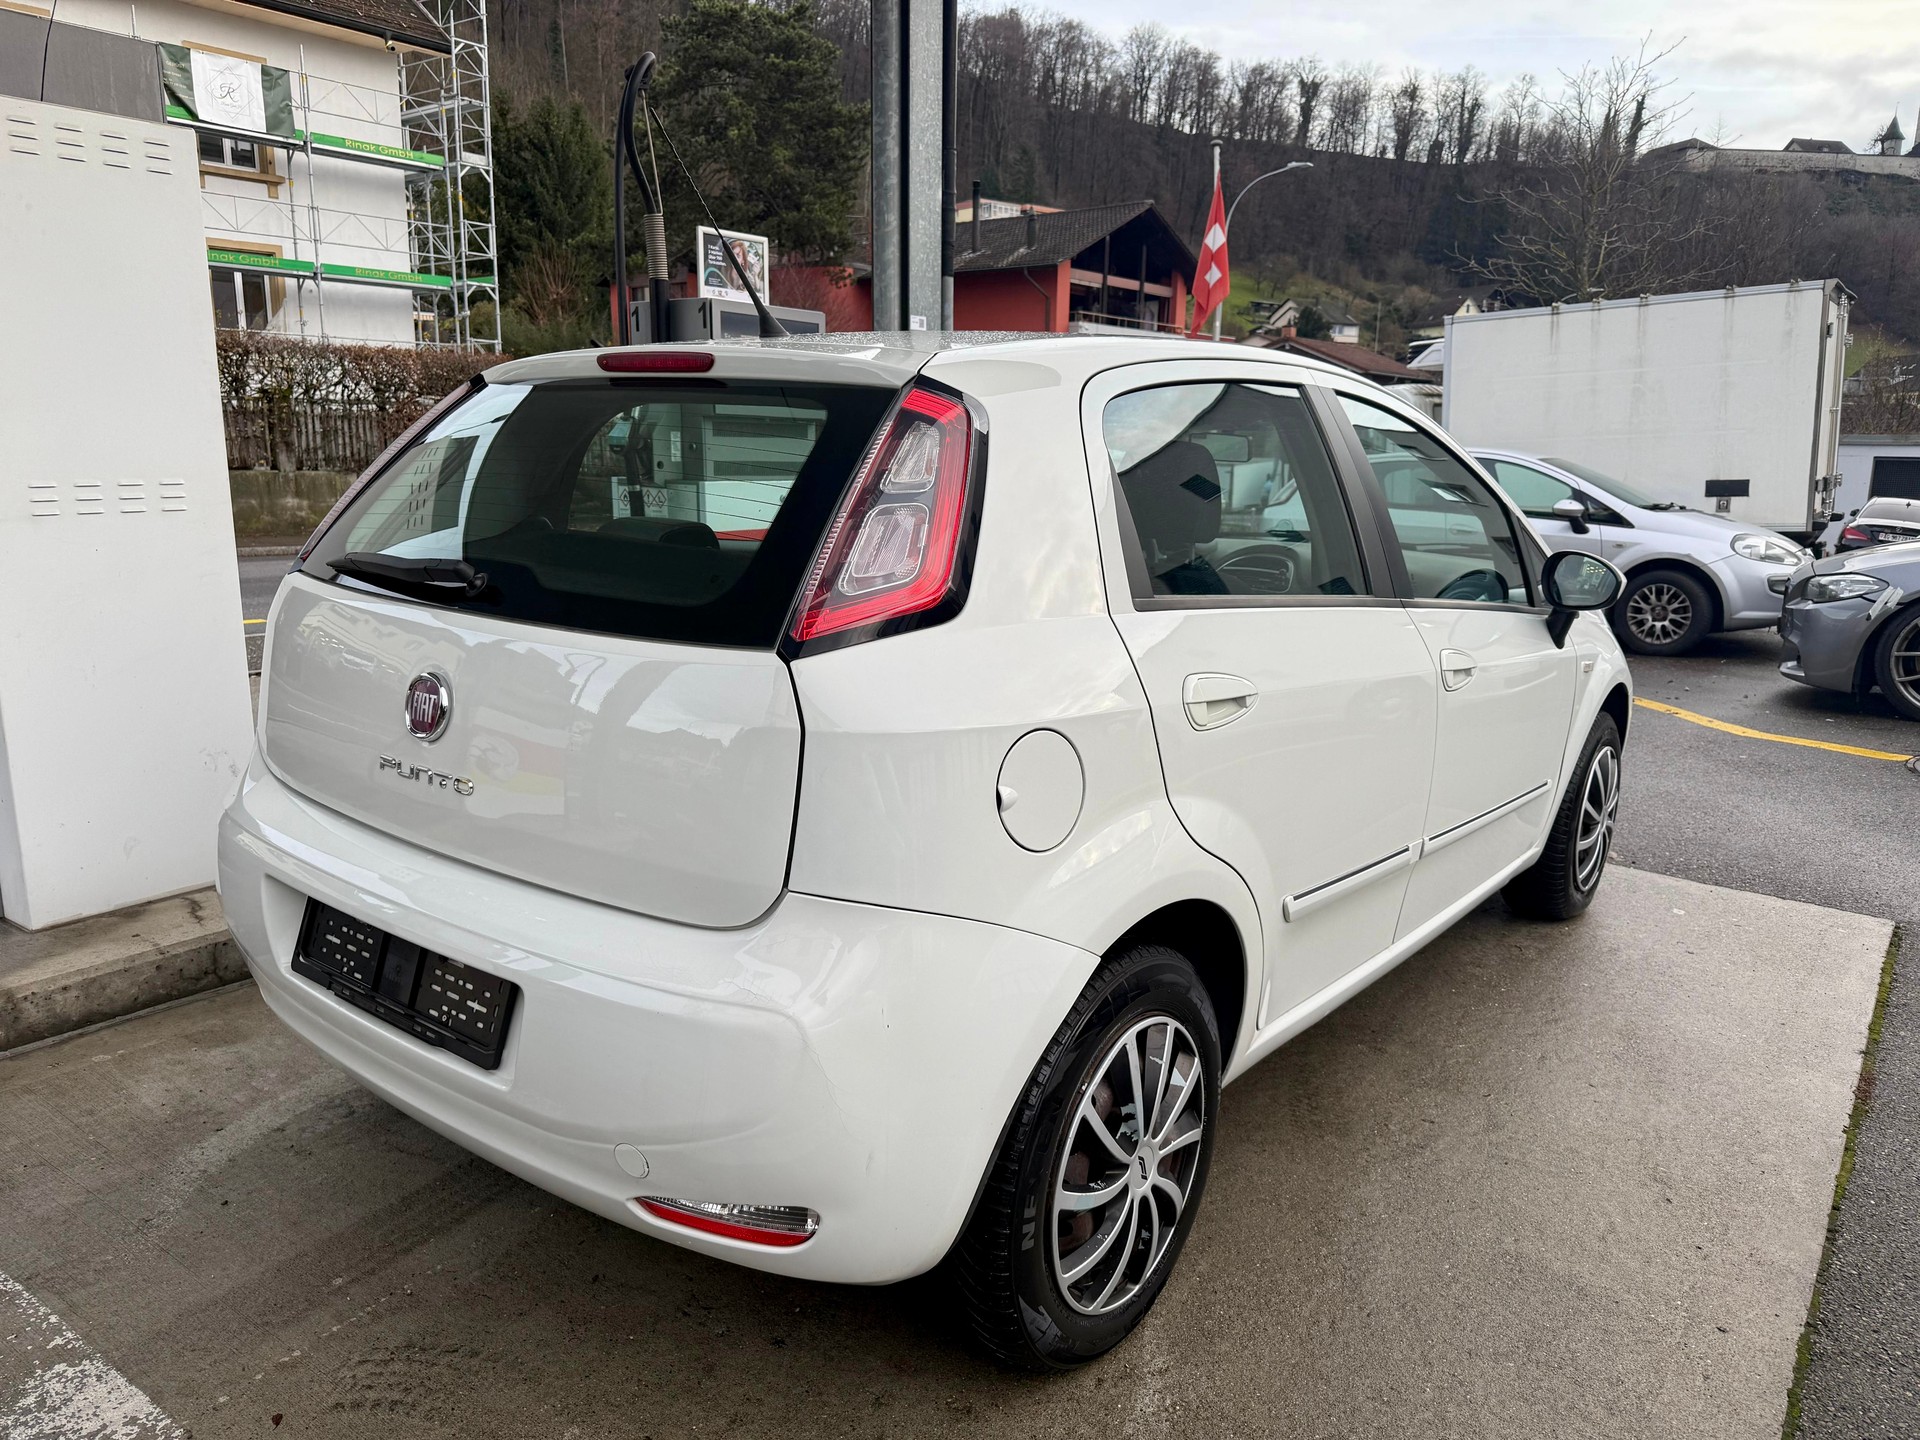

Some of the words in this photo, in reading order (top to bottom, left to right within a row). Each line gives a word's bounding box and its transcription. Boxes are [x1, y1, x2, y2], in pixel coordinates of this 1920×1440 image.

[345, 138, 376, 151] Rinak
[379, 145, 413, 158] GmbH
[208, 252, 235, 262] inak
[239, 255, 279, 267] GmbH
[355, 268, 385, 279] Rinak
[388, 273, 423, 284] GmbH
[632, 306, 640, 332] 1
[698, 301, 707, 329] 1
[411, 691, 438, 723] FIAT
[379, 754, 474, 796] PUNTO
